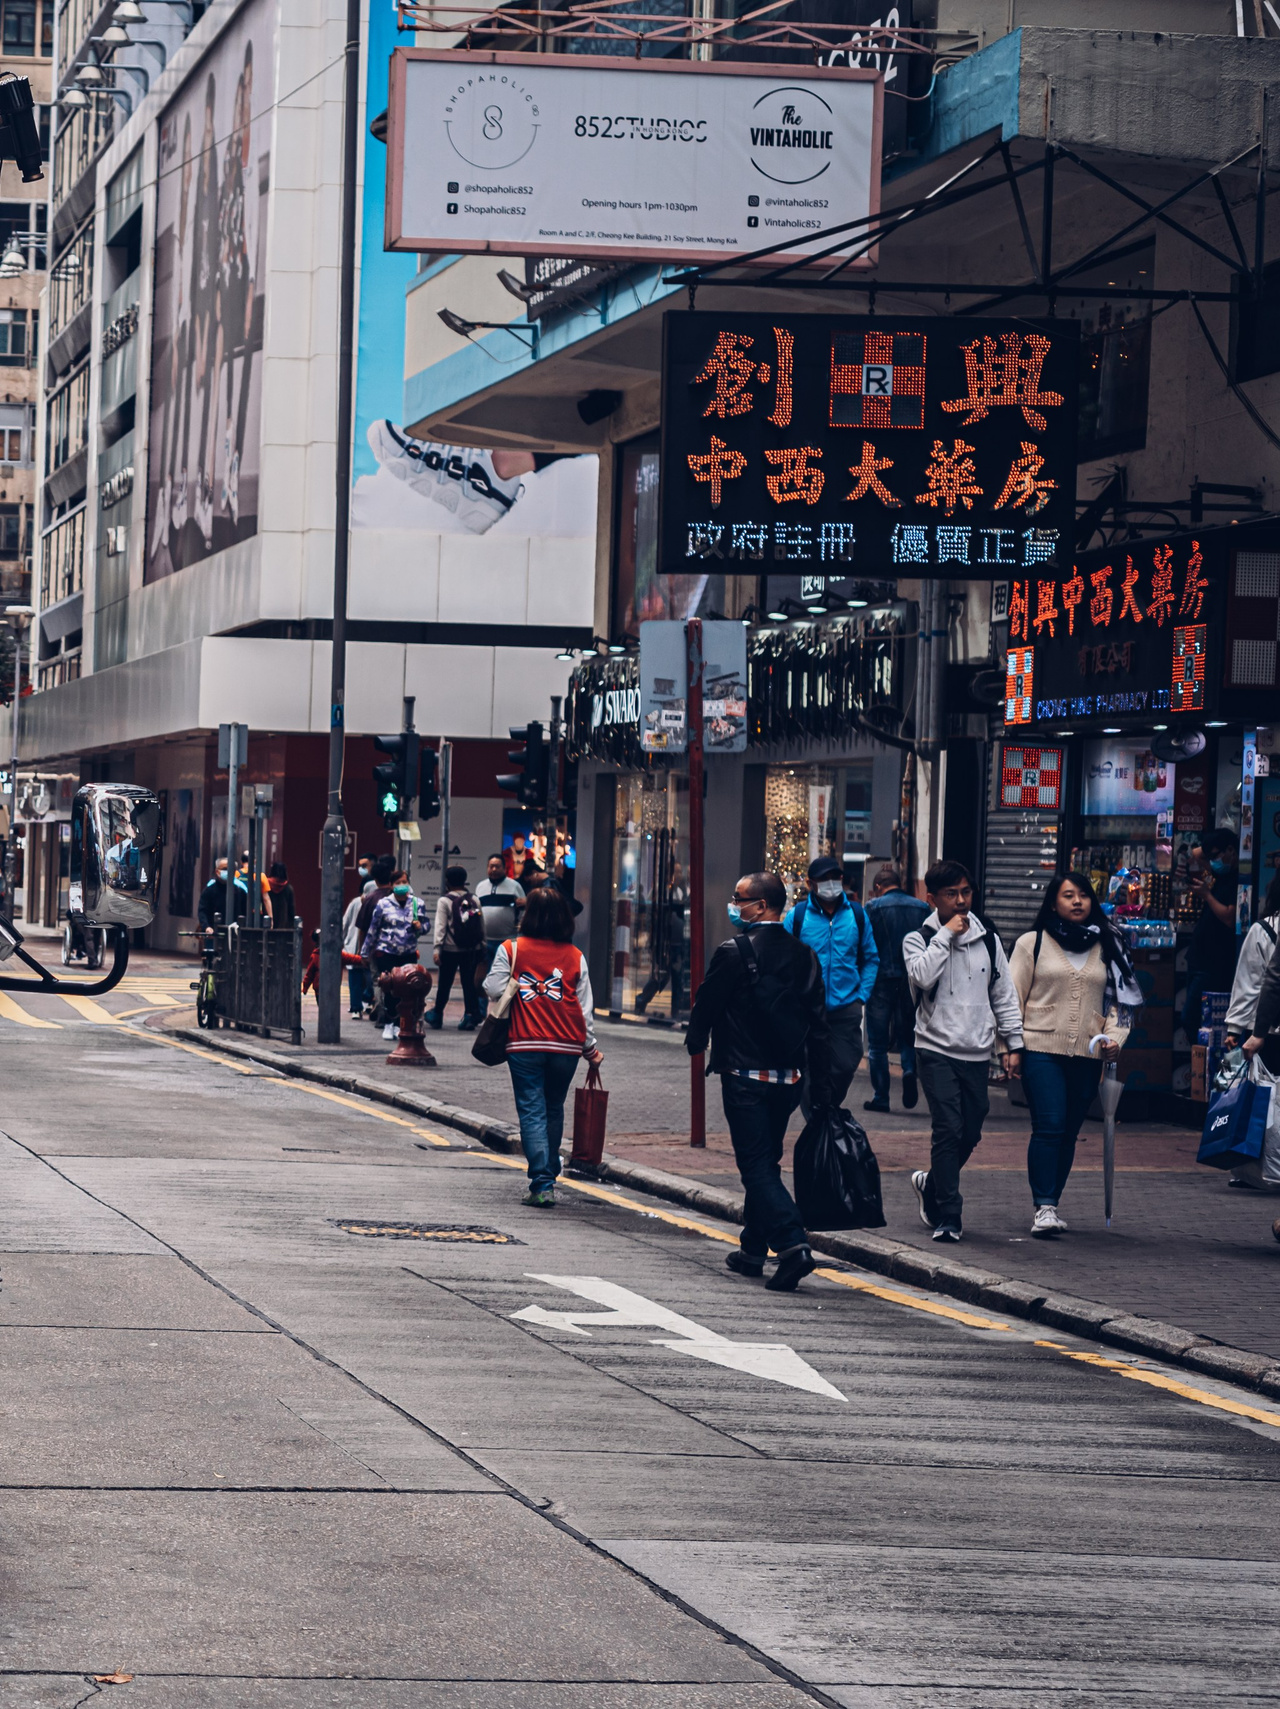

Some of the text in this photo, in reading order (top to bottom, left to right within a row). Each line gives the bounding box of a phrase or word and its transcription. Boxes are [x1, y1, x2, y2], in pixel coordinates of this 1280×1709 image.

[782, 105, 803, 126] The
[750, 127, 833, 149] VINTAHOLIC
[464, 184, 534, 195] @shopaholic852
[464, 204, 527, 216] Shopaholic852
[581, 198, 698, 212] Opening hours 1pm-1030pm
[765, 198, 829, 208] @vintaholic852
[764, 218, 822, 229] Vintaholic852
[539, 228, 557, 236] Room
[597, 231, 622, 241] Cheong
[706, 236, 725, 246] Mong
[691, 327, 1065, 431] 創 興
[687, 435, 1061, 517] 中西大藥房
[685, 519, 1062, 568] 政府註冊 優質正貨
[1008, 540, 1209, 642] 創興中西大藥房
[1036, 698, 1067, 720] CHONG
[1070, 696, 1093, 716] HING
[1096, 691, 1149, 714] PHARMACY
